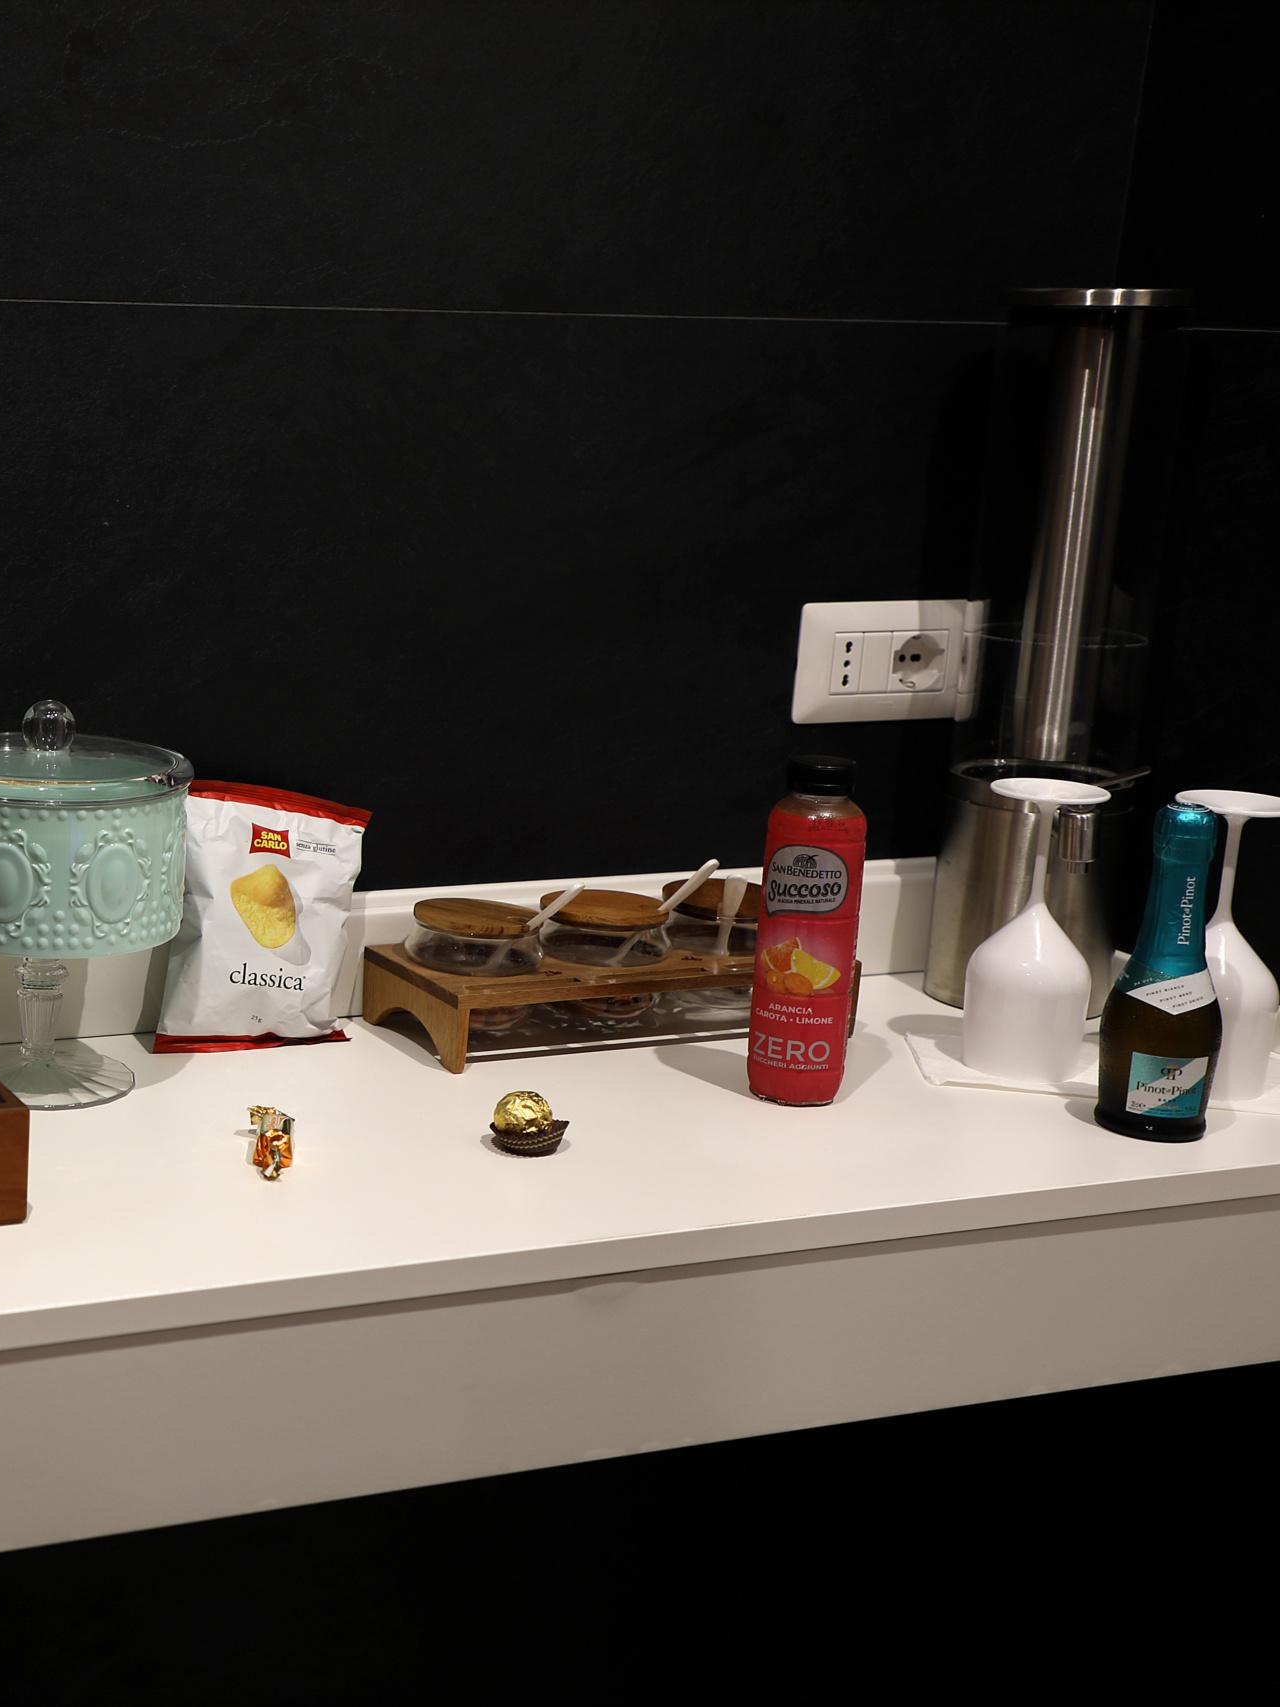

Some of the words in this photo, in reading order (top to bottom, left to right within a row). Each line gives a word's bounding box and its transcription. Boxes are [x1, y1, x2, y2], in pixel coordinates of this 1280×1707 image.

[260, 831, 282, 842] SAN
[253, 838, 288, 850] CARLO
[229, 962, 304, 992] classica
[768, 1002, 813, 1015] ARANCIA
[755, 1006, 788, 1023] CAROTA
[795, 1016, 833, 1025] LIMONE
[752, 1030, 831, 1062] ZERO
[788, 1063, 829, 1071] AGGIUNTI
